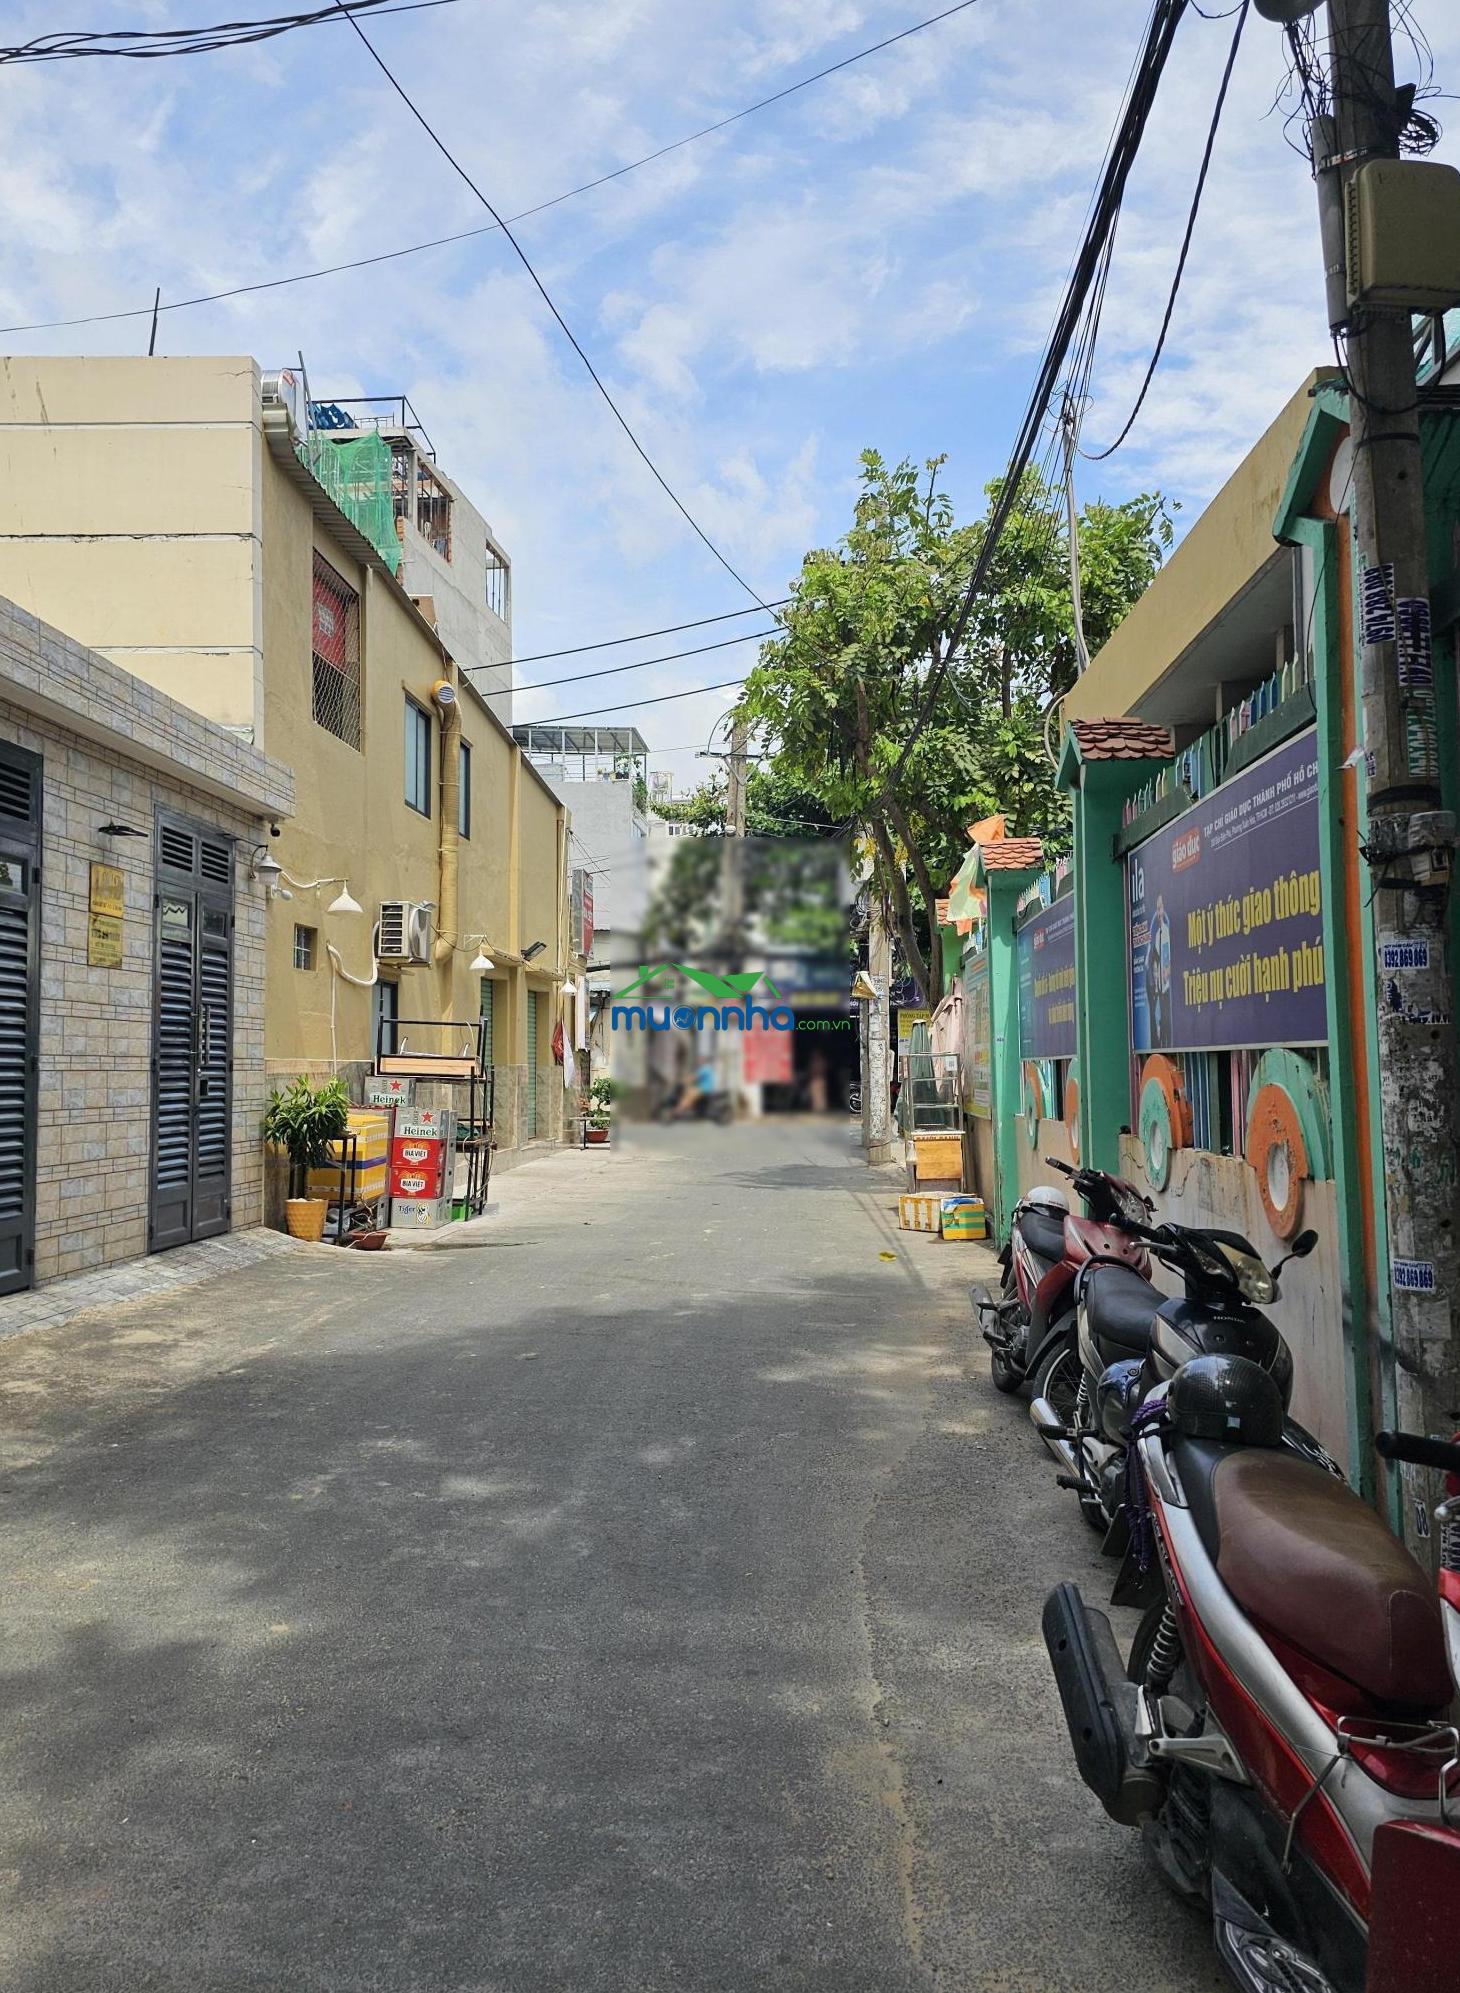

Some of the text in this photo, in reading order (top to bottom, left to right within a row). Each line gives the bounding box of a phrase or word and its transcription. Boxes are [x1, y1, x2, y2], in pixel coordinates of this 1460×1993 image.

[1224, 806, 1238, 825] GIÁO
[1238, 799, 1252, 816] DỤC
[1252, 786, 1275, 808] THÀNH
[1276, 770, 1292, 795] PHỐ
[1293, 763, 1305, 786] HỒ
[1187, 908, 1207, 955] Một
[1207, 903, 1214, 947] ý
[1215, 894, 1241, 940] thức
[1242, 886, 1272, 936] giao
[1273, 870, 1320, 920] thông
[1183, 967, 1208, 1013] Triệu
[1209, 968, 1224, 1010] nụ
[1225, 953, 1252, 999] cười
[1253, 946, 1290, 1003] hạnh
[398, 1205, 415, 1215] Tiger
